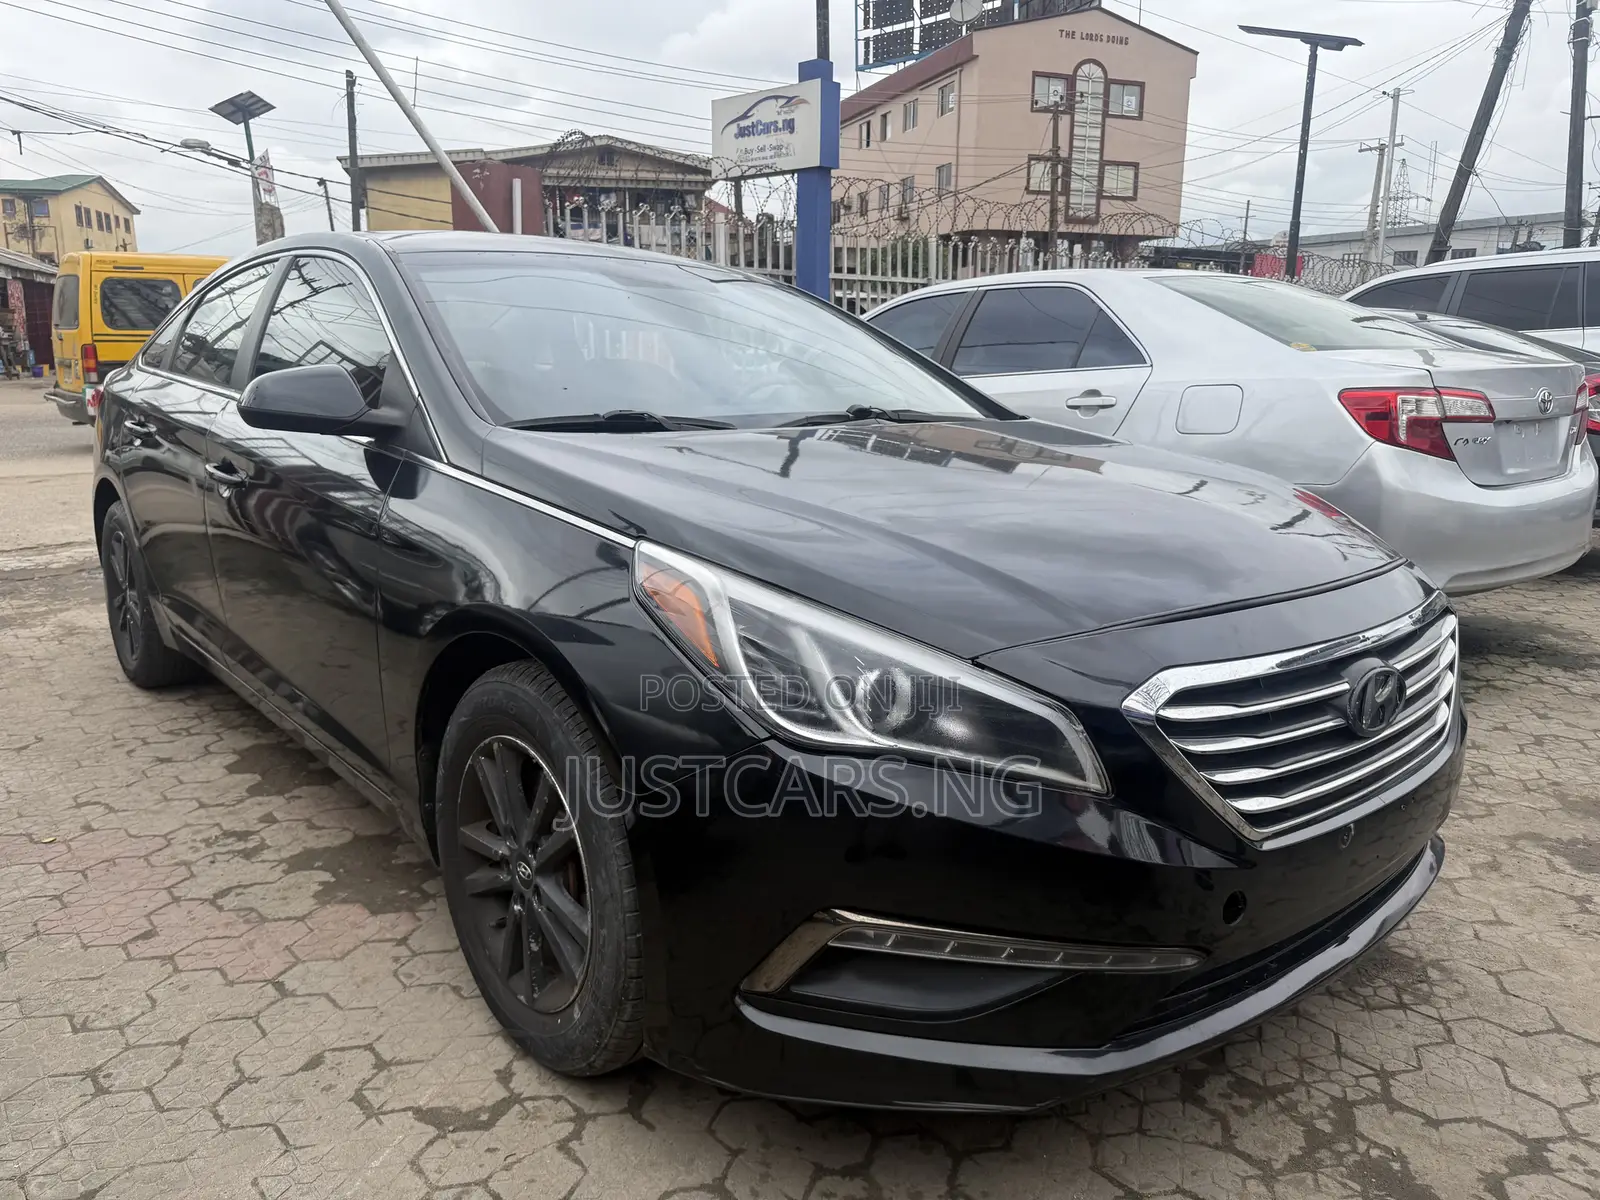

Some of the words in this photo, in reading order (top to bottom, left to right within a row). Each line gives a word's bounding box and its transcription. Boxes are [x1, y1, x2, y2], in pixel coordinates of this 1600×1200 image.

[1059, 29, 1076, 39] THE
[1106, 35, 1129, 46] DOING
[734, 117, 795, 140] JustCars.ng
